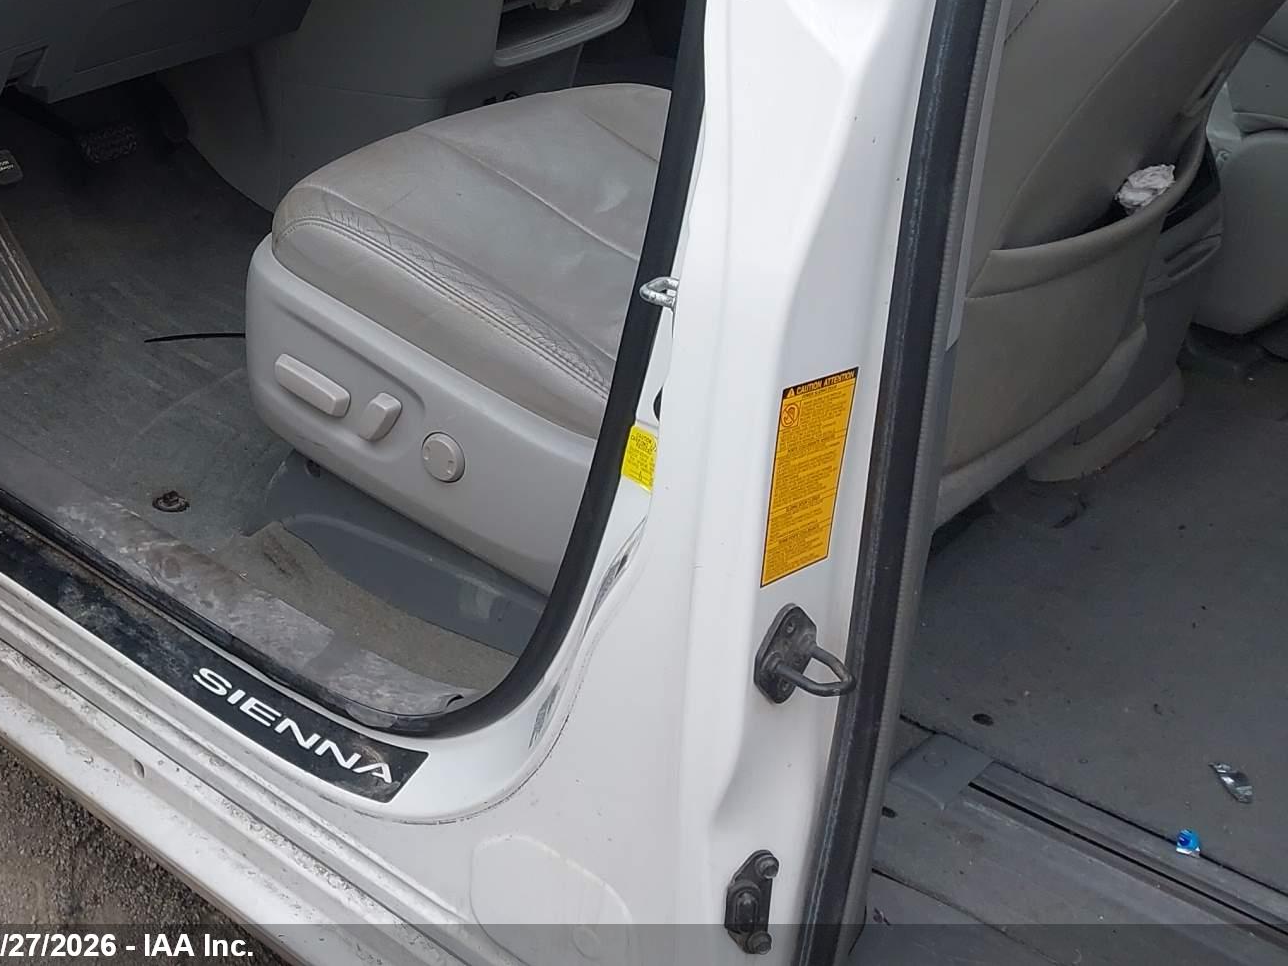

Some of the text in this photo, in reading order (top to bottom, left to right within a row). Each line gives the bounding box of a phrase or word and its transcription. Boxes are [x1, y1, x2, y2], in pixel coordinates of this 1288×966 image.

[796, 379, 823, 395] CAUTION
[823, 370, 855, 387] ATTENTION
[192, 667, 394, 784] SIENNA
